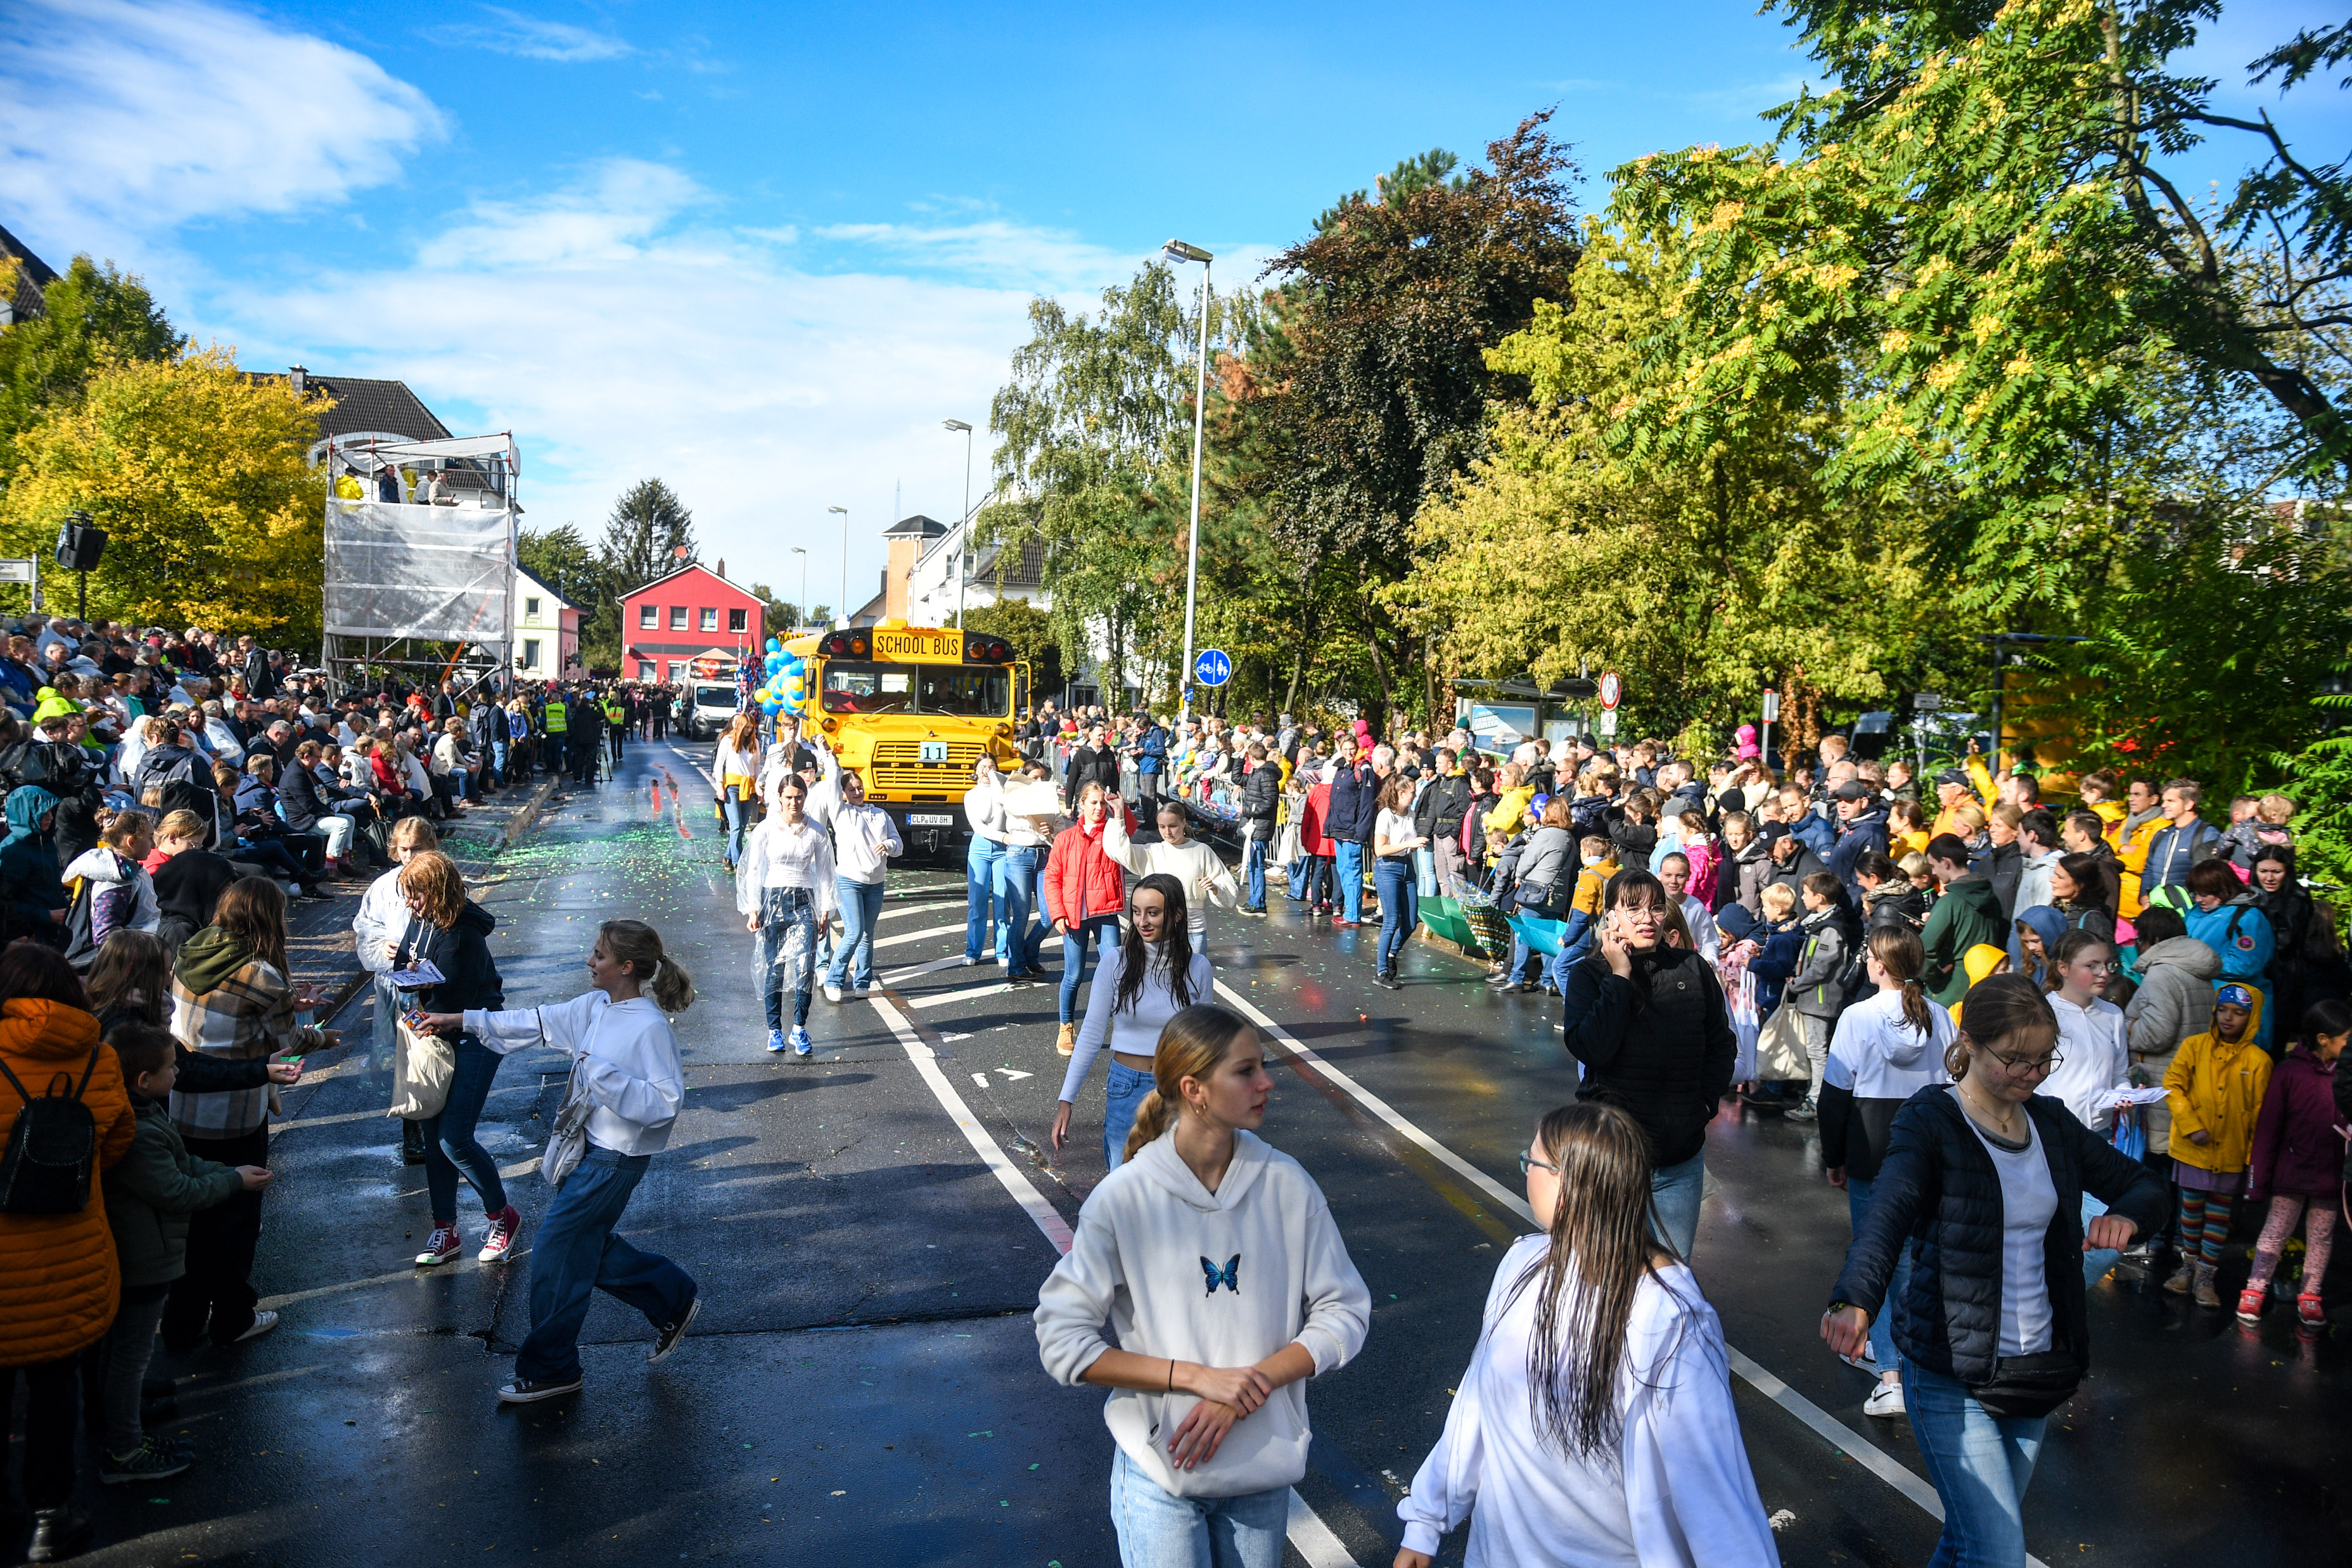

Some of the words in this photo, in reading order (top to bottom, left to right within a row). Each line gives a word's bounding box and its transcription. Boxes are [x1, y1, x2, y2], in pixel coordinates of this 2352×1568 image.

[877, 635, 927, 654] SCHOOL
[933, 638, 958, 656] BUS
[924, 746, 943, 760] 11
[929, 815, 938, 824] UV
